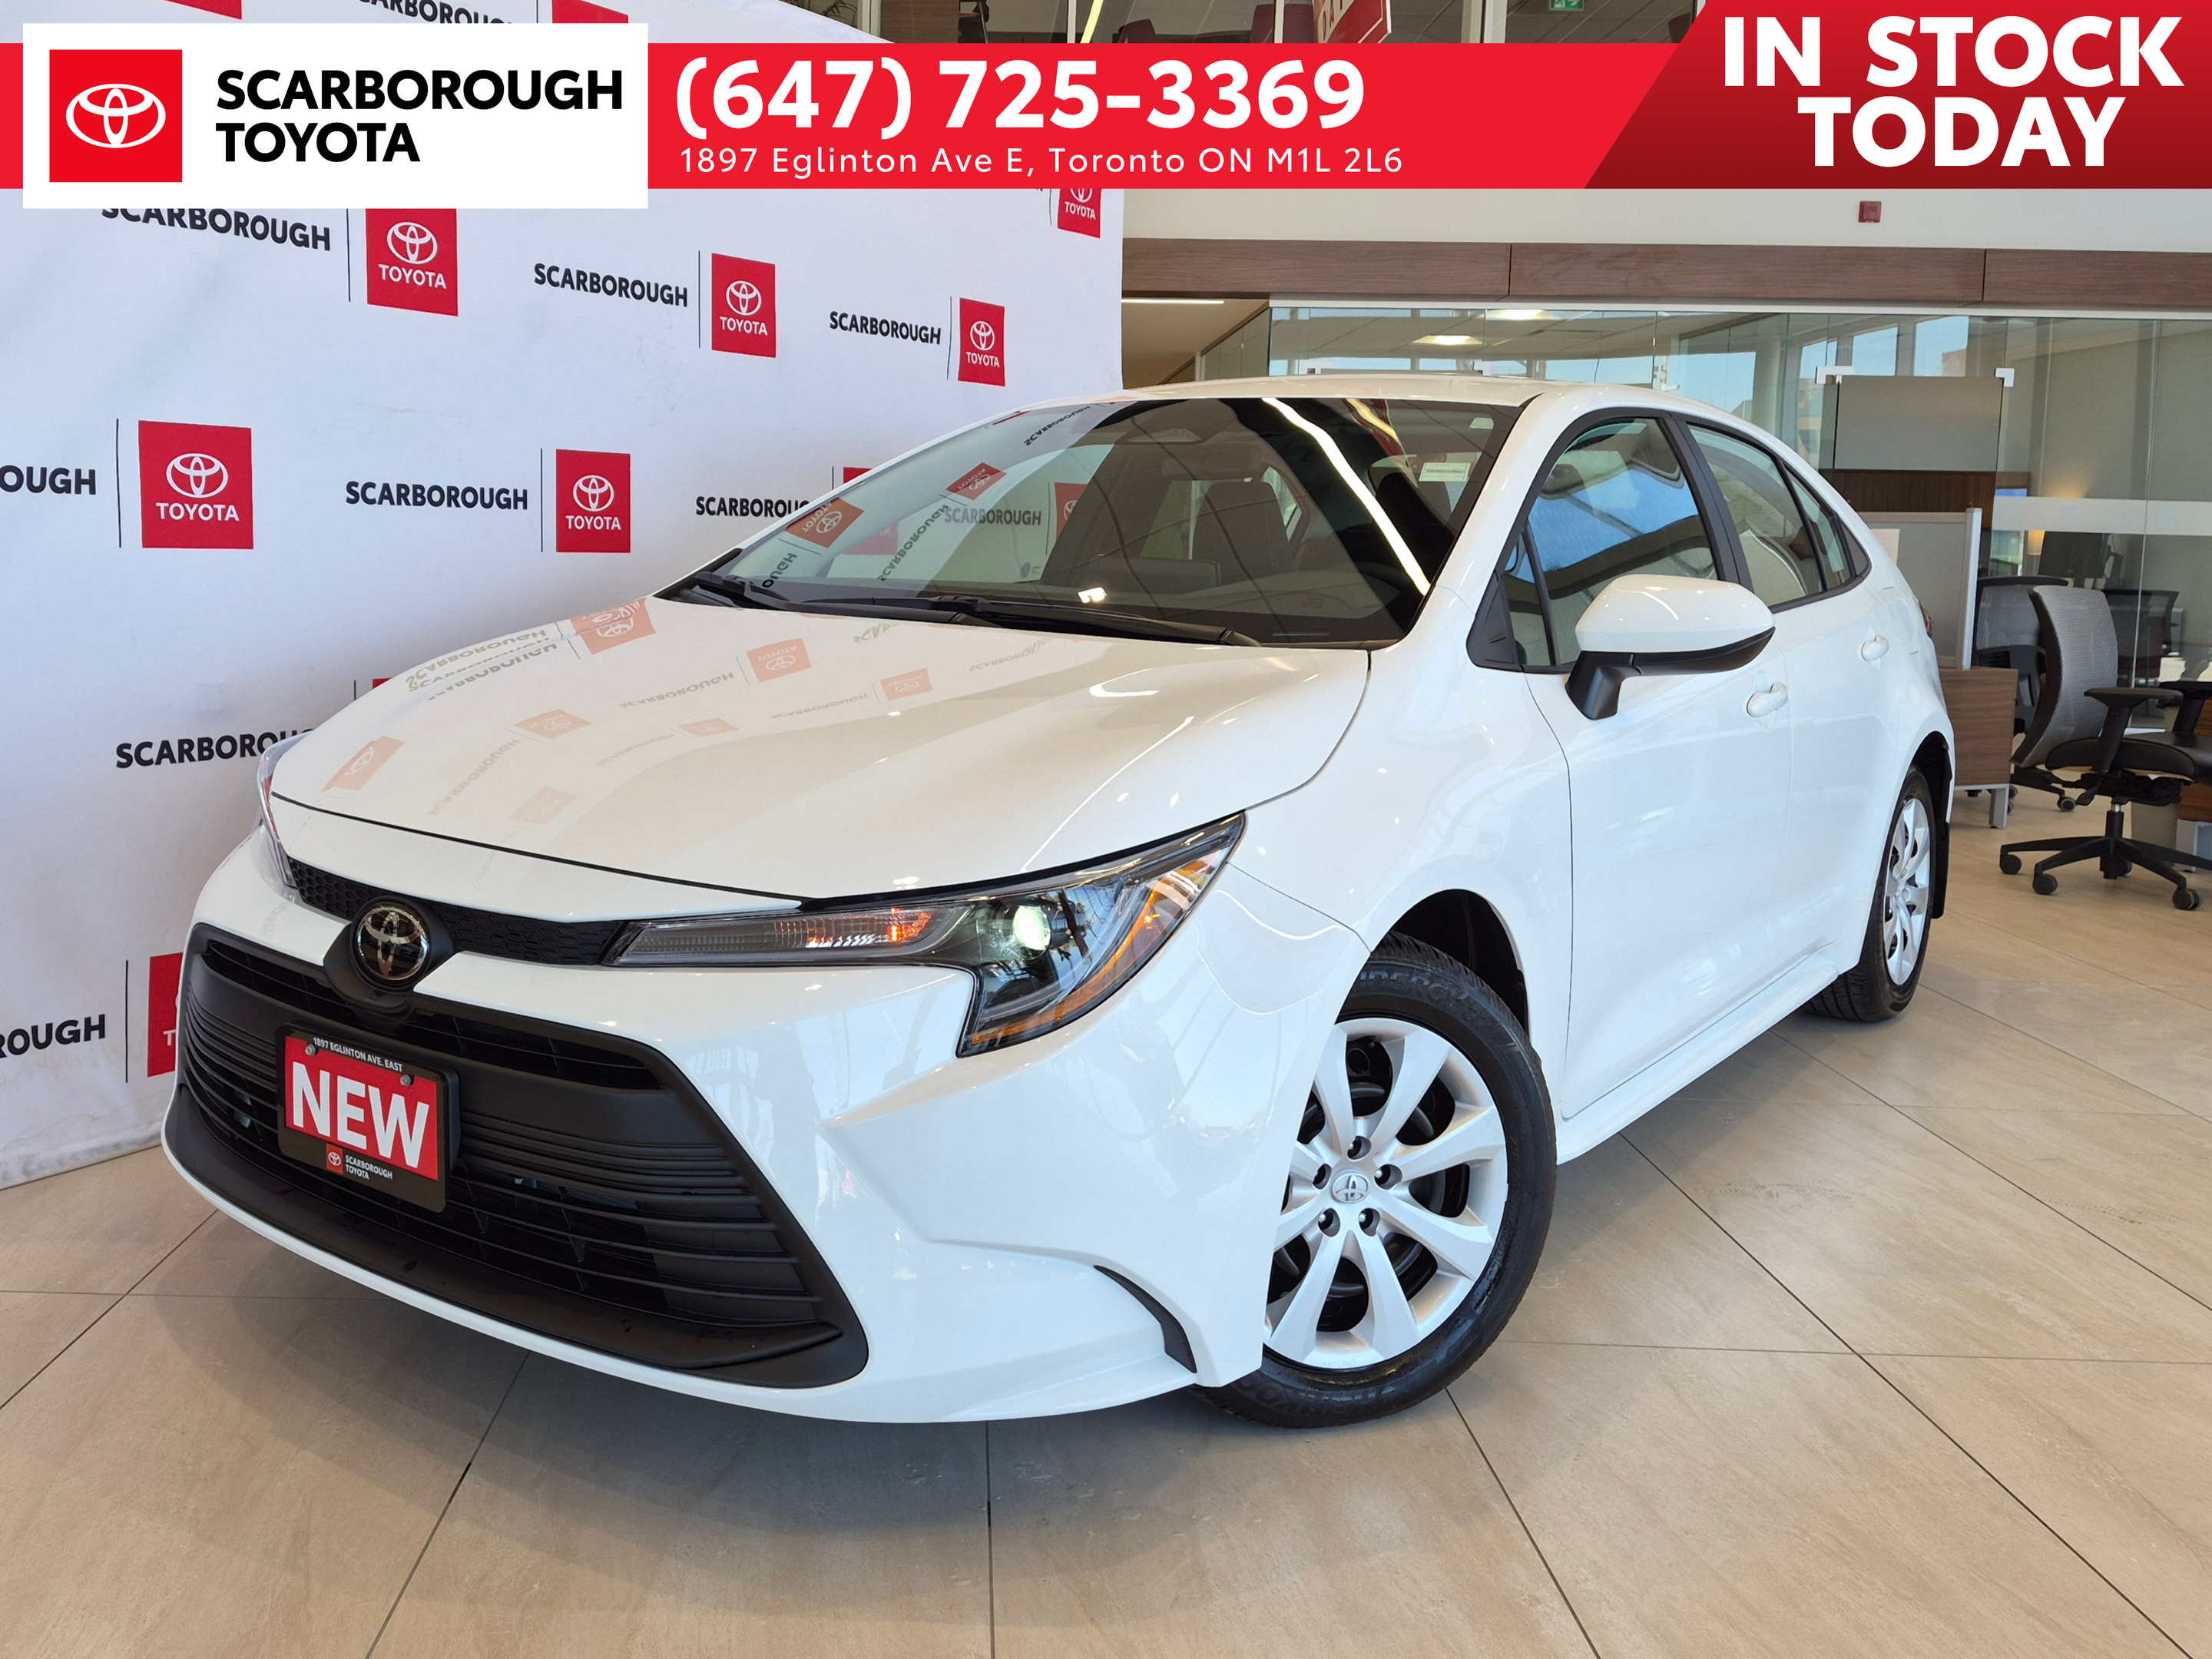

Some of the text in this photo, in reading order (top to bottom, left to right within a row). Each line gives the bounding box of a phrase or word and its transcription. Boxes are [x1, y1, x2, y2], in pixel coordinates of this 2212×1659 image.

[1065, 201, 1096, 220] TOYOTA
[379, 263, 447, 289] TOYOTA
[534, 263, 687, 307] SCARBOROUGH
[720, 316, 768, 336] TOYOTA
[830, 311, 941, 345] SCARBOROUGH
[965, 351, 1000, 368] TOYOTA
[346, 481, 528, 510] SCARBOROUGH
[155, 502, 240, 522] TOYOTA
[565, 515, 621, 530] TOYOTA
[313, 1037, 403, 1072] 1897 EGLINTON AVE. EAST
[293, 1061, 430, 1169] NEW
[345, 1154, 393, 1180] SCARBOROUGH
[345, 1164, 369, 1180] TOYOTA
